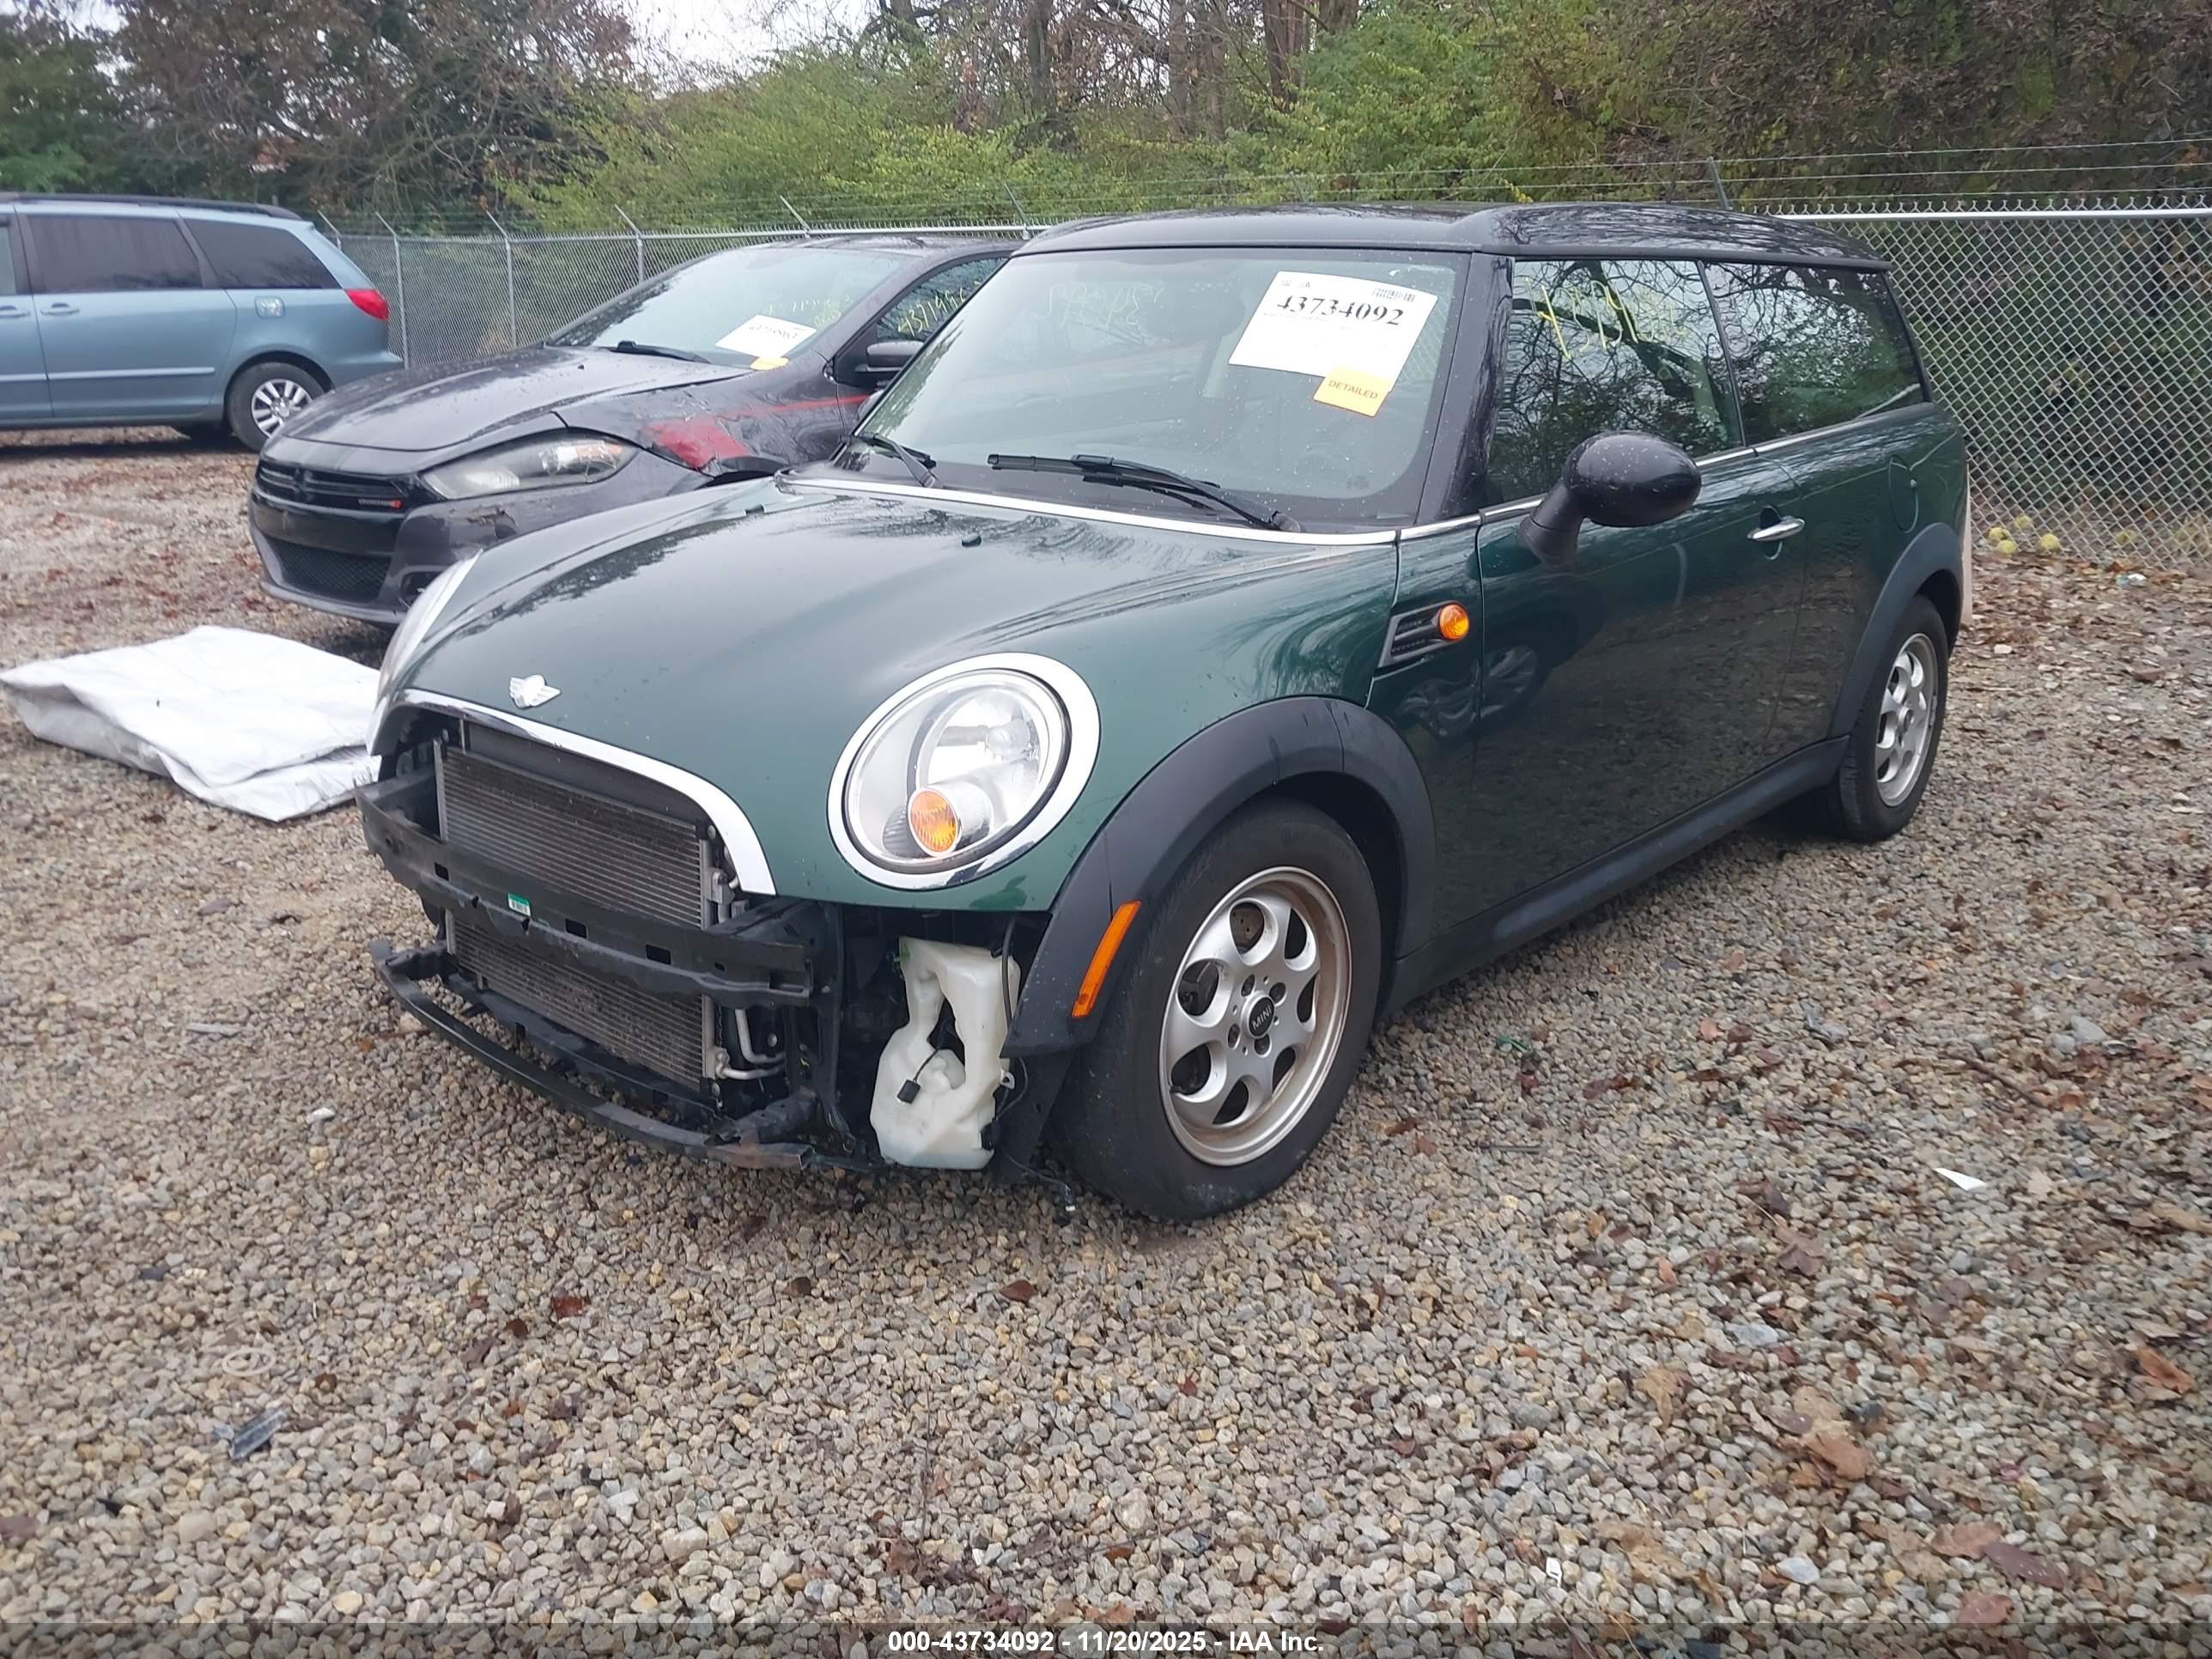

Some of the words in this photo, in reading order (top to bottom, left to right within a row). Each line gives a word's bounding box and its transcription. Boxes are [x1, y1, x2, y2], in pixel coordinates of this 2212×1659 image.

[1276, 295, 1405, 326] 43734092
[1328, 380, 1379, 399] DETAILED
[1251, 1004, 1272, 1030] MINI
